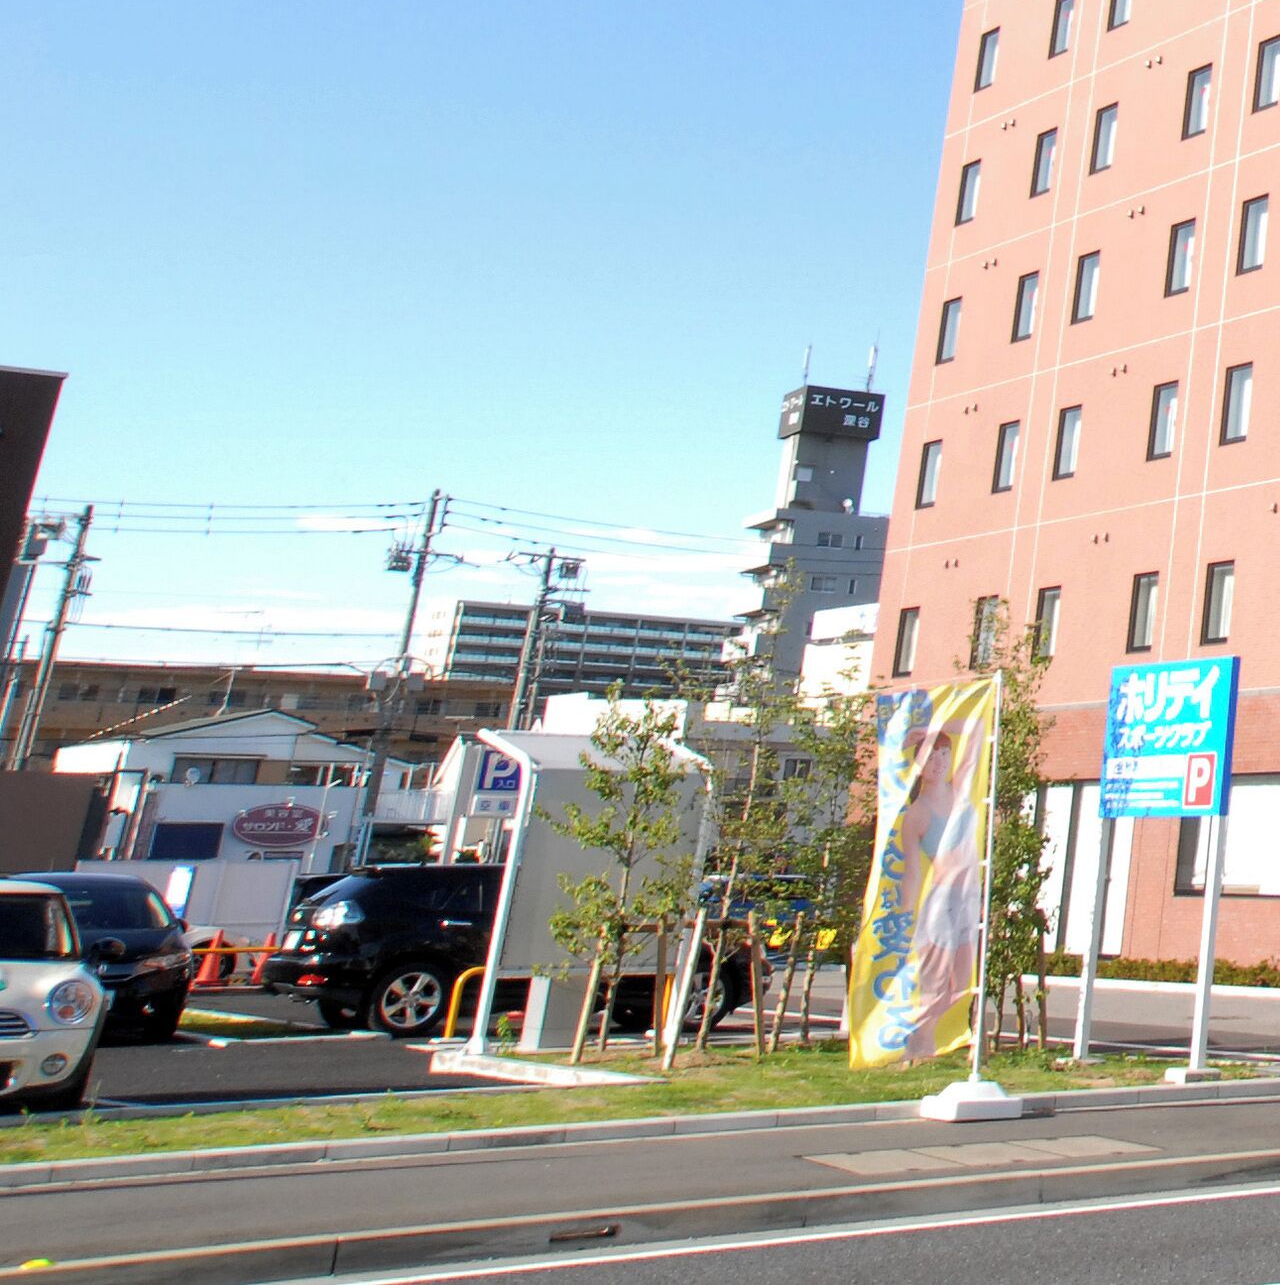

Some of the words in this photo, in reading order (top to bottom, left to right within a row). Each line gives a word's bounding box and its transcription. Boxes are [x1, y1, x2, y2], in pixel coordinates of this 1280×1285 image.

[811, 394, 880, 412] エトワール
[484, 753, 517, 789] P
[496, 780, 516, 789] 入口
[1188, 757, 1211, 803] P
